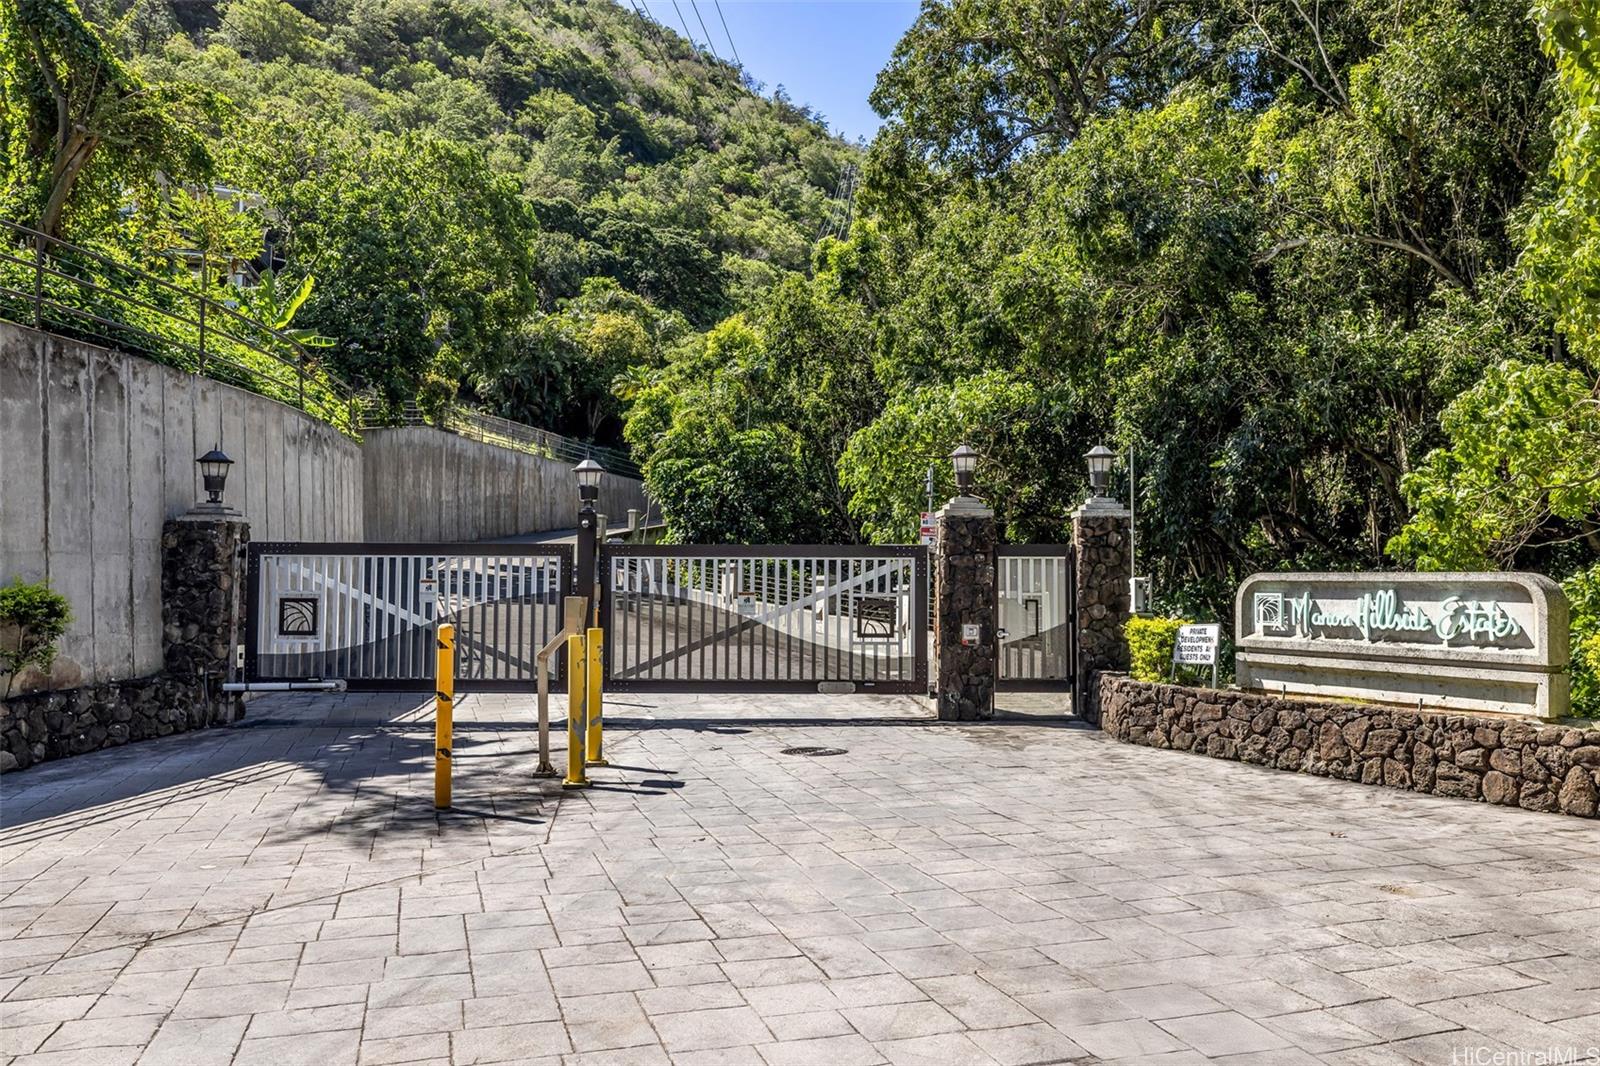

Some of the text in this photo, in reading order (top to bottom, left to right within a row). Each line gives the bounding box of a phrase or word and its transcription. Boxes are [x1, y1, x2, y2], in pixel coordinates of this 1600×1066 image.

[1291, 589, 1521, 641] Manoa Hillside Estates
[1189, 627, 1208, 635] PRIVATE
[1177, 645, 1204, 653] RESIDENTS
[1199, 653, 1212, 661] ONLY
